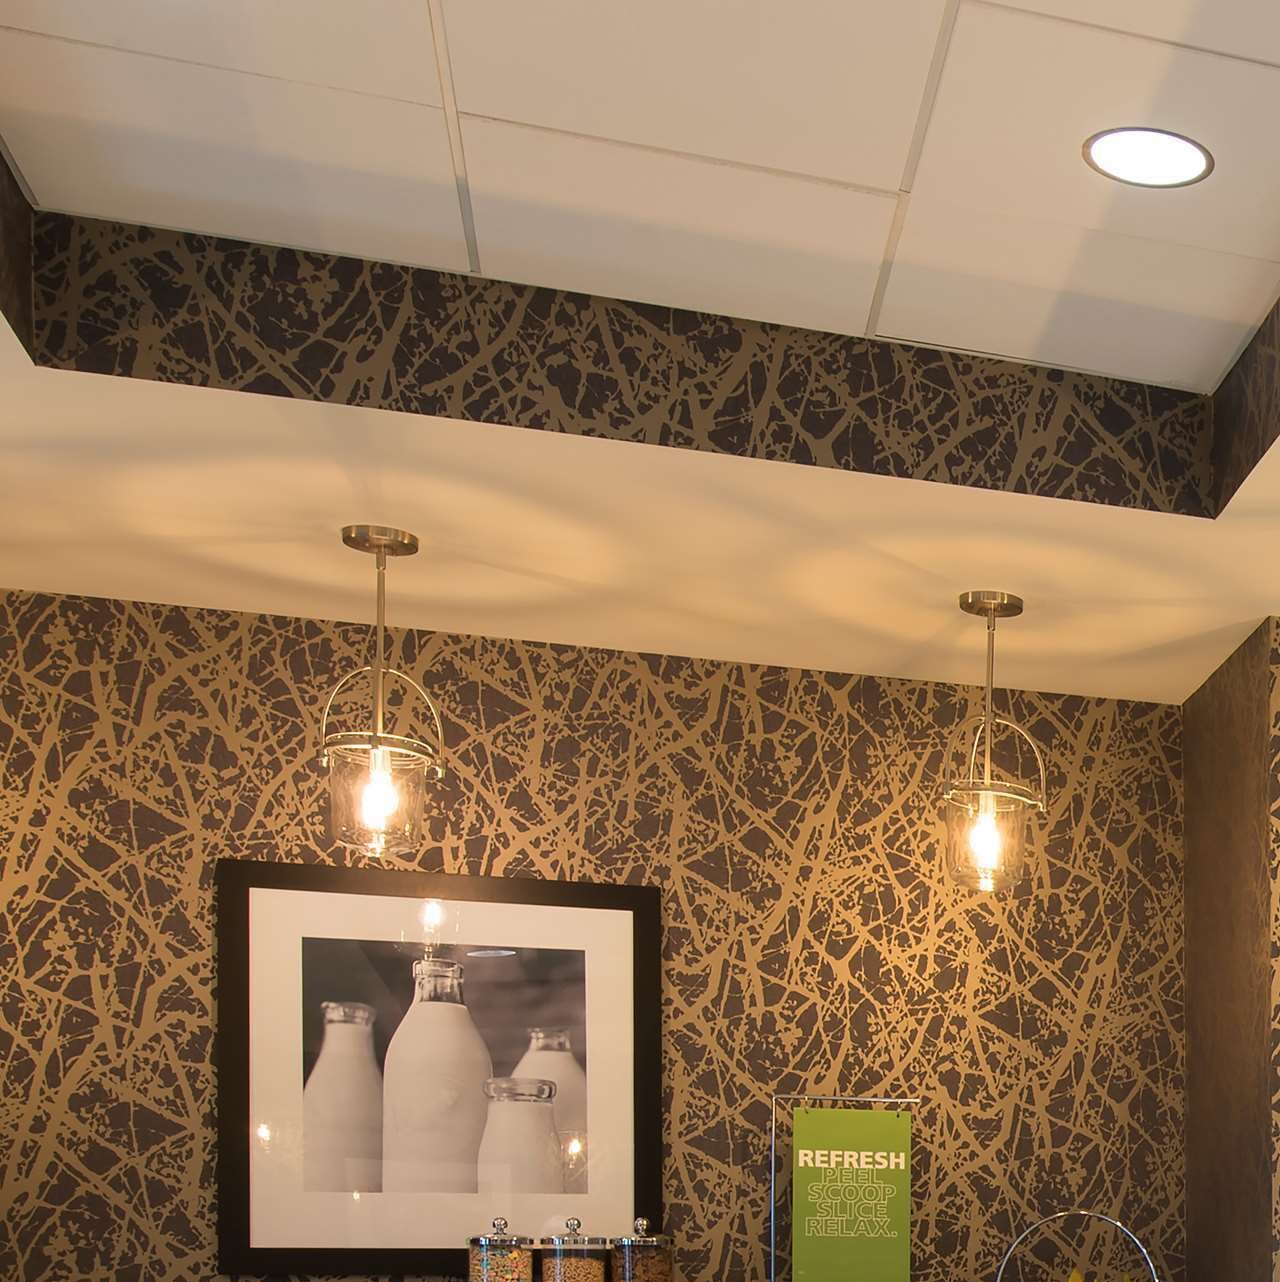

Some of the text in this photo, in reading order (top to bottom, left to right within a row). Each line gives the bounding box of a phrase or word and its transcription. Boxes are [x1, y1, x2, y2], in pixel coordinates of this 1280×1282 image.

[798, 1149, 906, 1170] REFRESH
[821, 1167, 884, 1185] PEEL
[808, 1184, 897, 1202] SCOOP
[816, 1201, 887, 1220] SLICE
[805, 1217, 898, 1238] RELAX.
